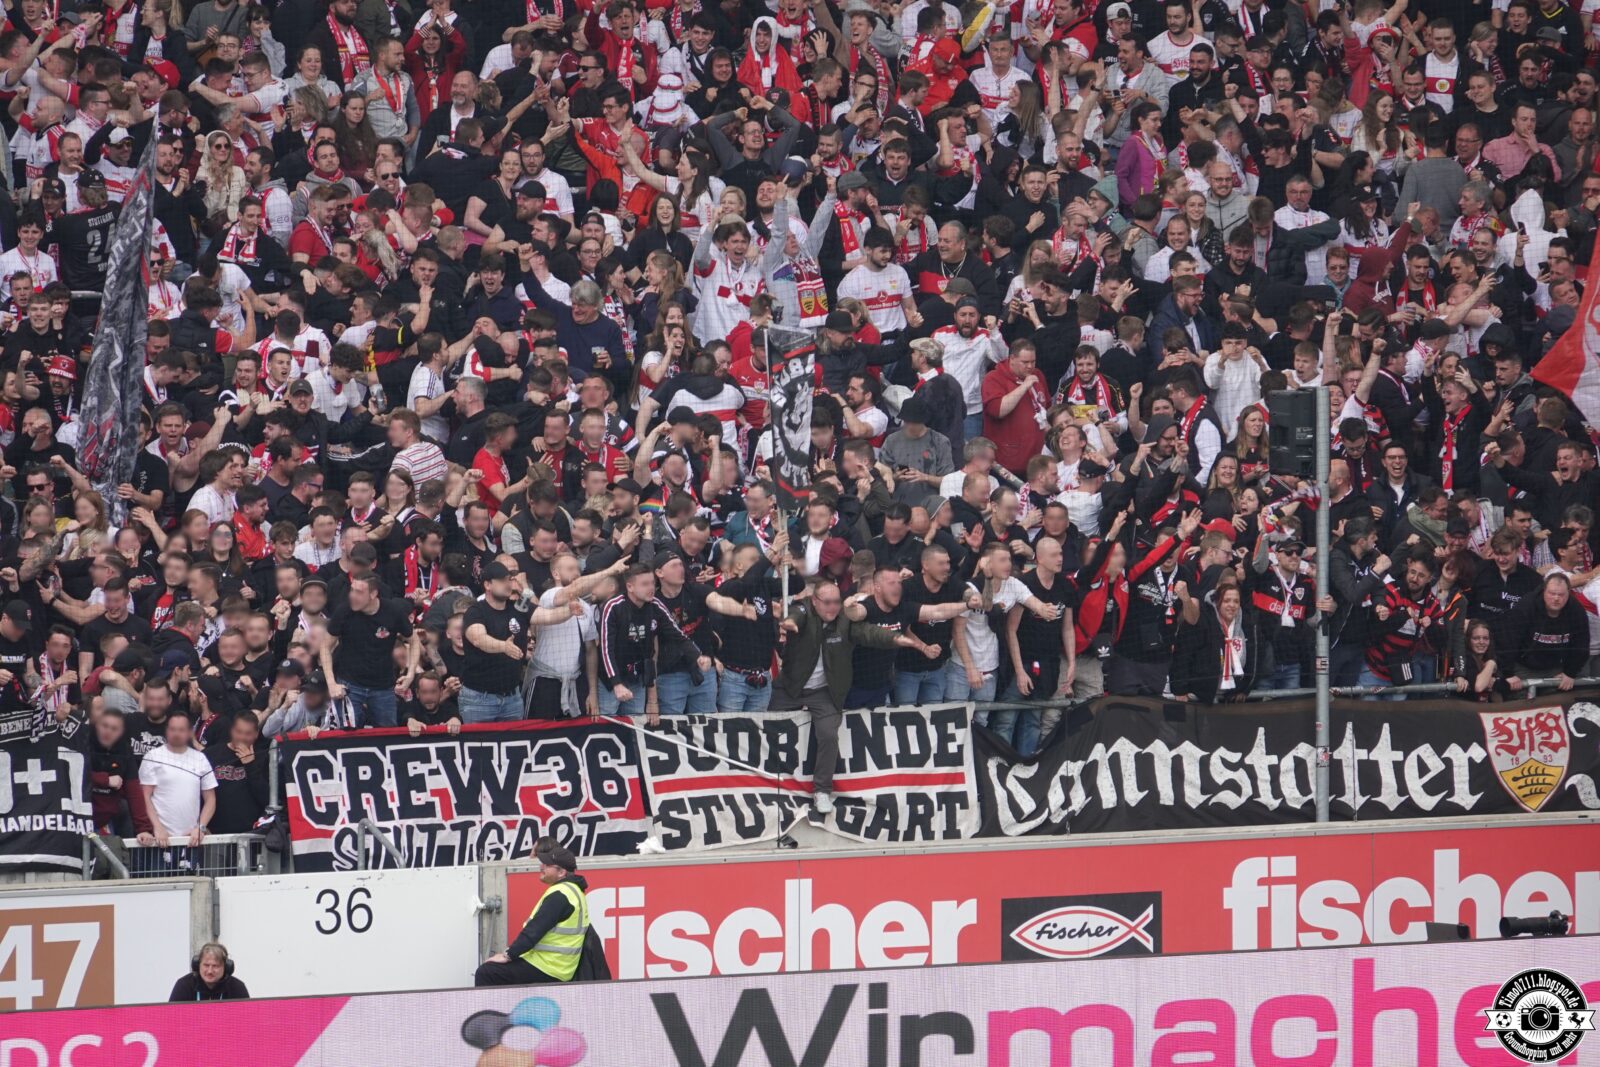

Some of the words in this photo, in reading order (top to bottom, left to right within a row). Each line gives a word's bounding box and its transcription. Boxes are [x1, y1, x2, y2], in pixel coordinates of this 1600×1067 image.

[644, 706, 968, 777] SÜDBNDE
[314, 886, 374, 935] 36
[1035, 921, 1119, 941] fischer
[0, 921, 101, 1011] 47
